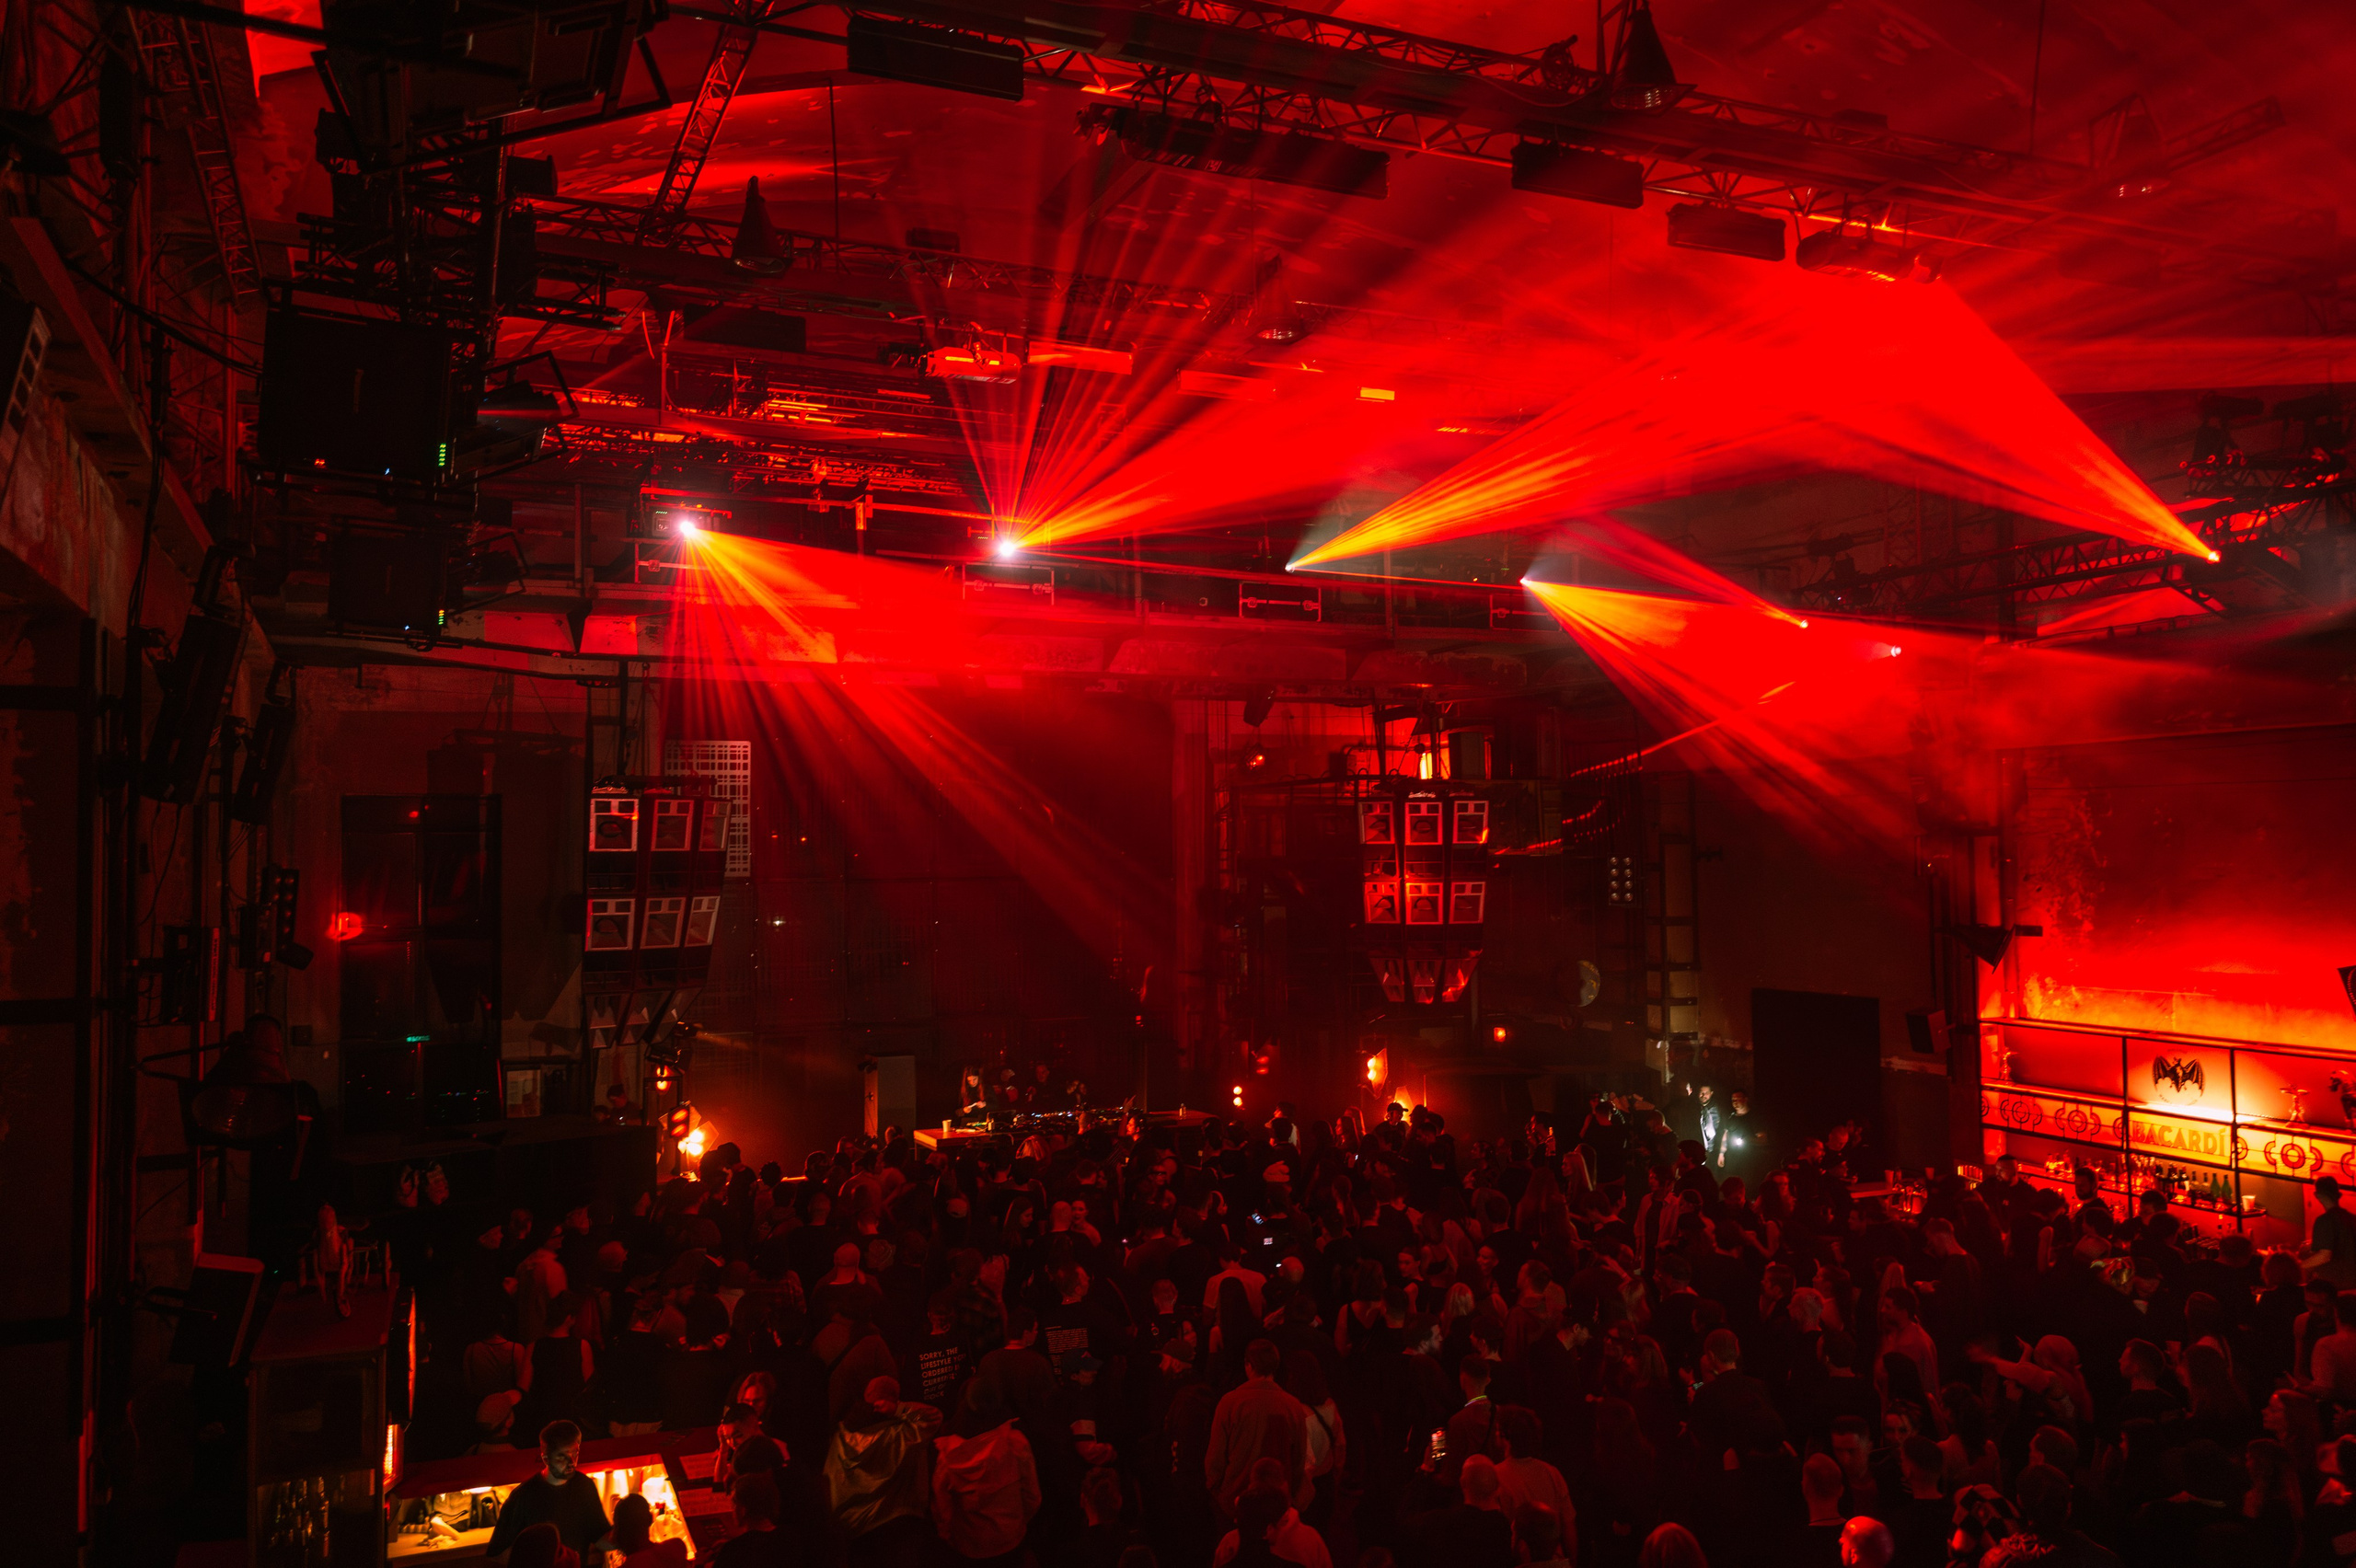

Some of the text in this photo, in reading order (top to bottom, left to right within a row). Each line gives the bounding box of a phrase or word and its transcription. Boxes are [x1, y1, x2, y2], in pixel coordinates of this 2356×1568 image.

[2131, 1121, 2226, 1156] BACARDÍ
[919, 1347, 958, 1361] SORRY, THE
[920, 1357, 952, 1370] LIFESTYLE
[921, 1366, 953, 1378] ORDERED
